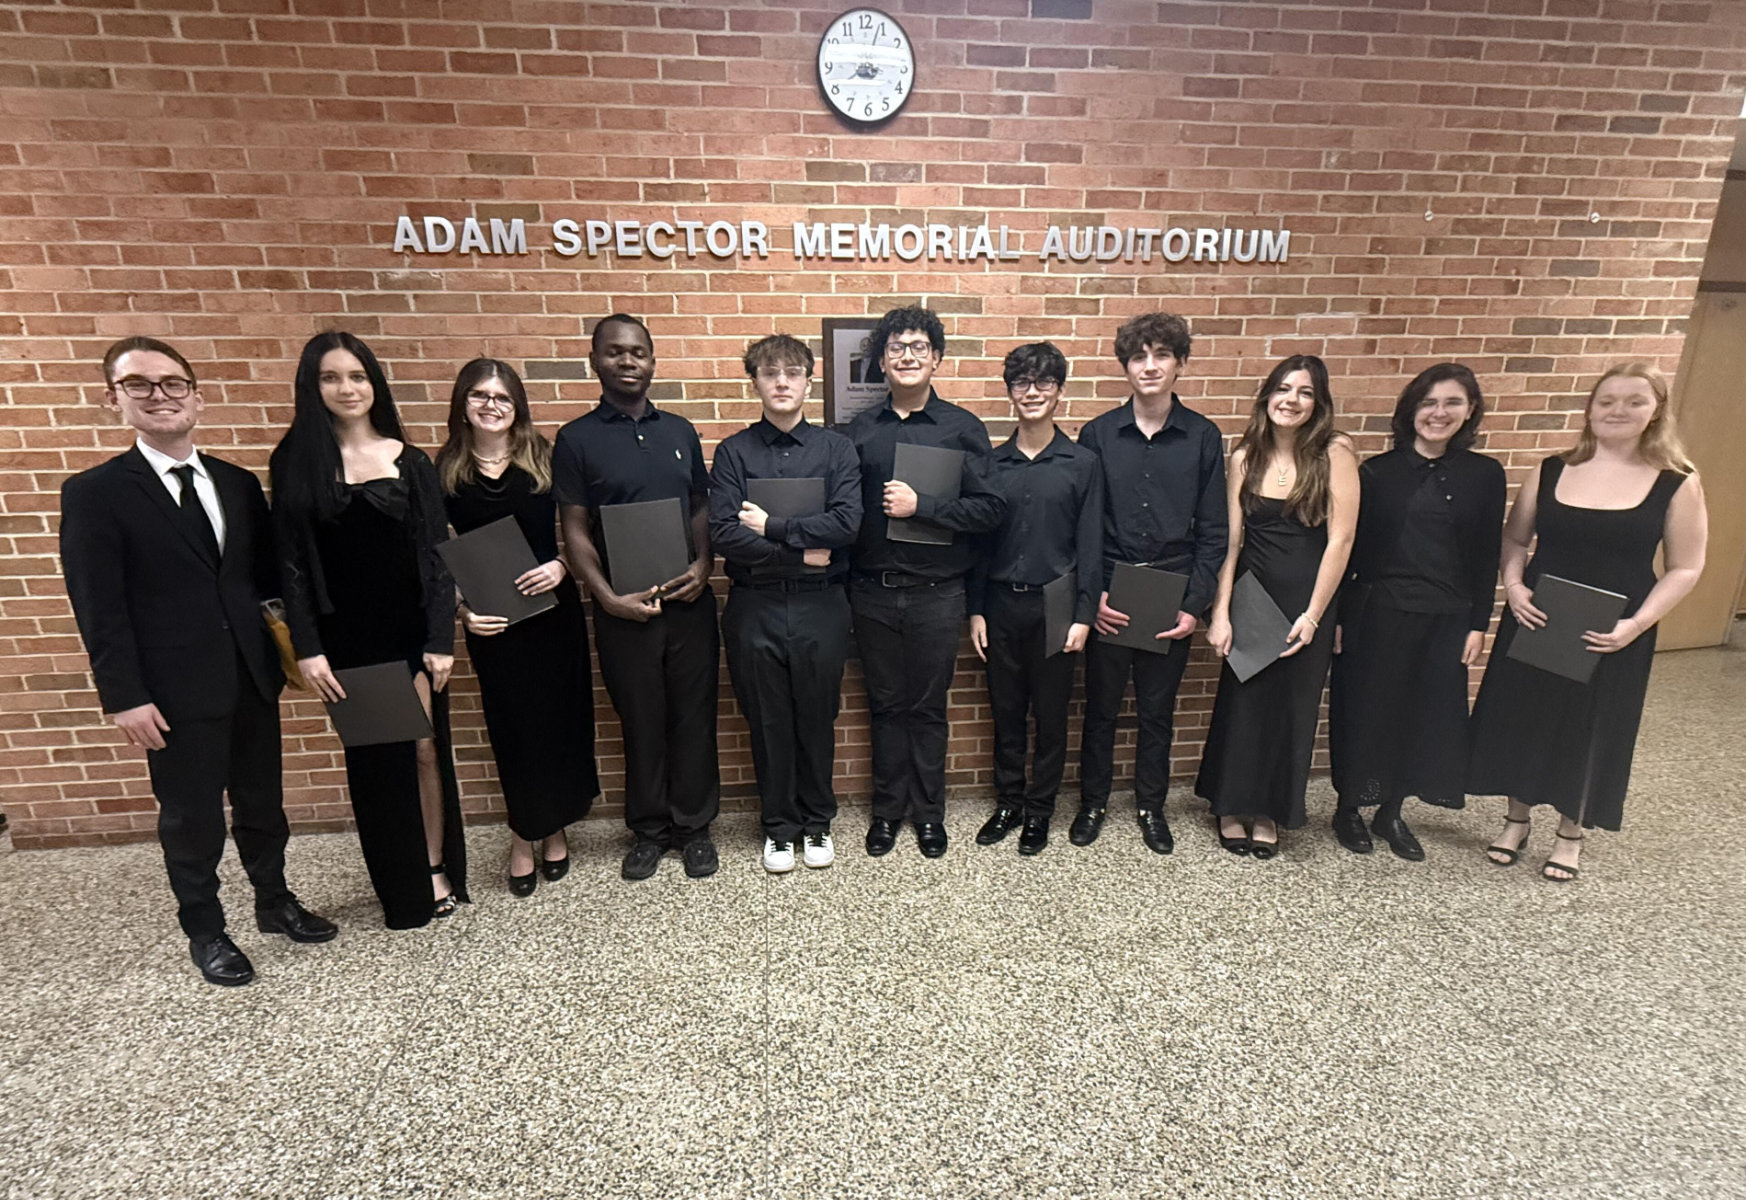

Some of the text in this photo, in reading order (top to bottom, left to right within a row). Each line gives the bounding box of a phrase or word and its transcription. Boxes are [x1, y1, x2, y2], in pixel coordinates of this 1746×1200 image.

[842, 22, 853, 37] 11
[859, 14, 873, 30] 12
[880, 22, 887, 37] 1
[824, 61, 833, 75] 9
[894, 80, 903, 94] 4
[846, 97, 856, 112] 7
[864, 102, 873, 117] 6
[881, 97, 890, 112] 5
[393, 215, 1291, 264] ADAM SPECTOR MEMORIAL AUDITORIUM
